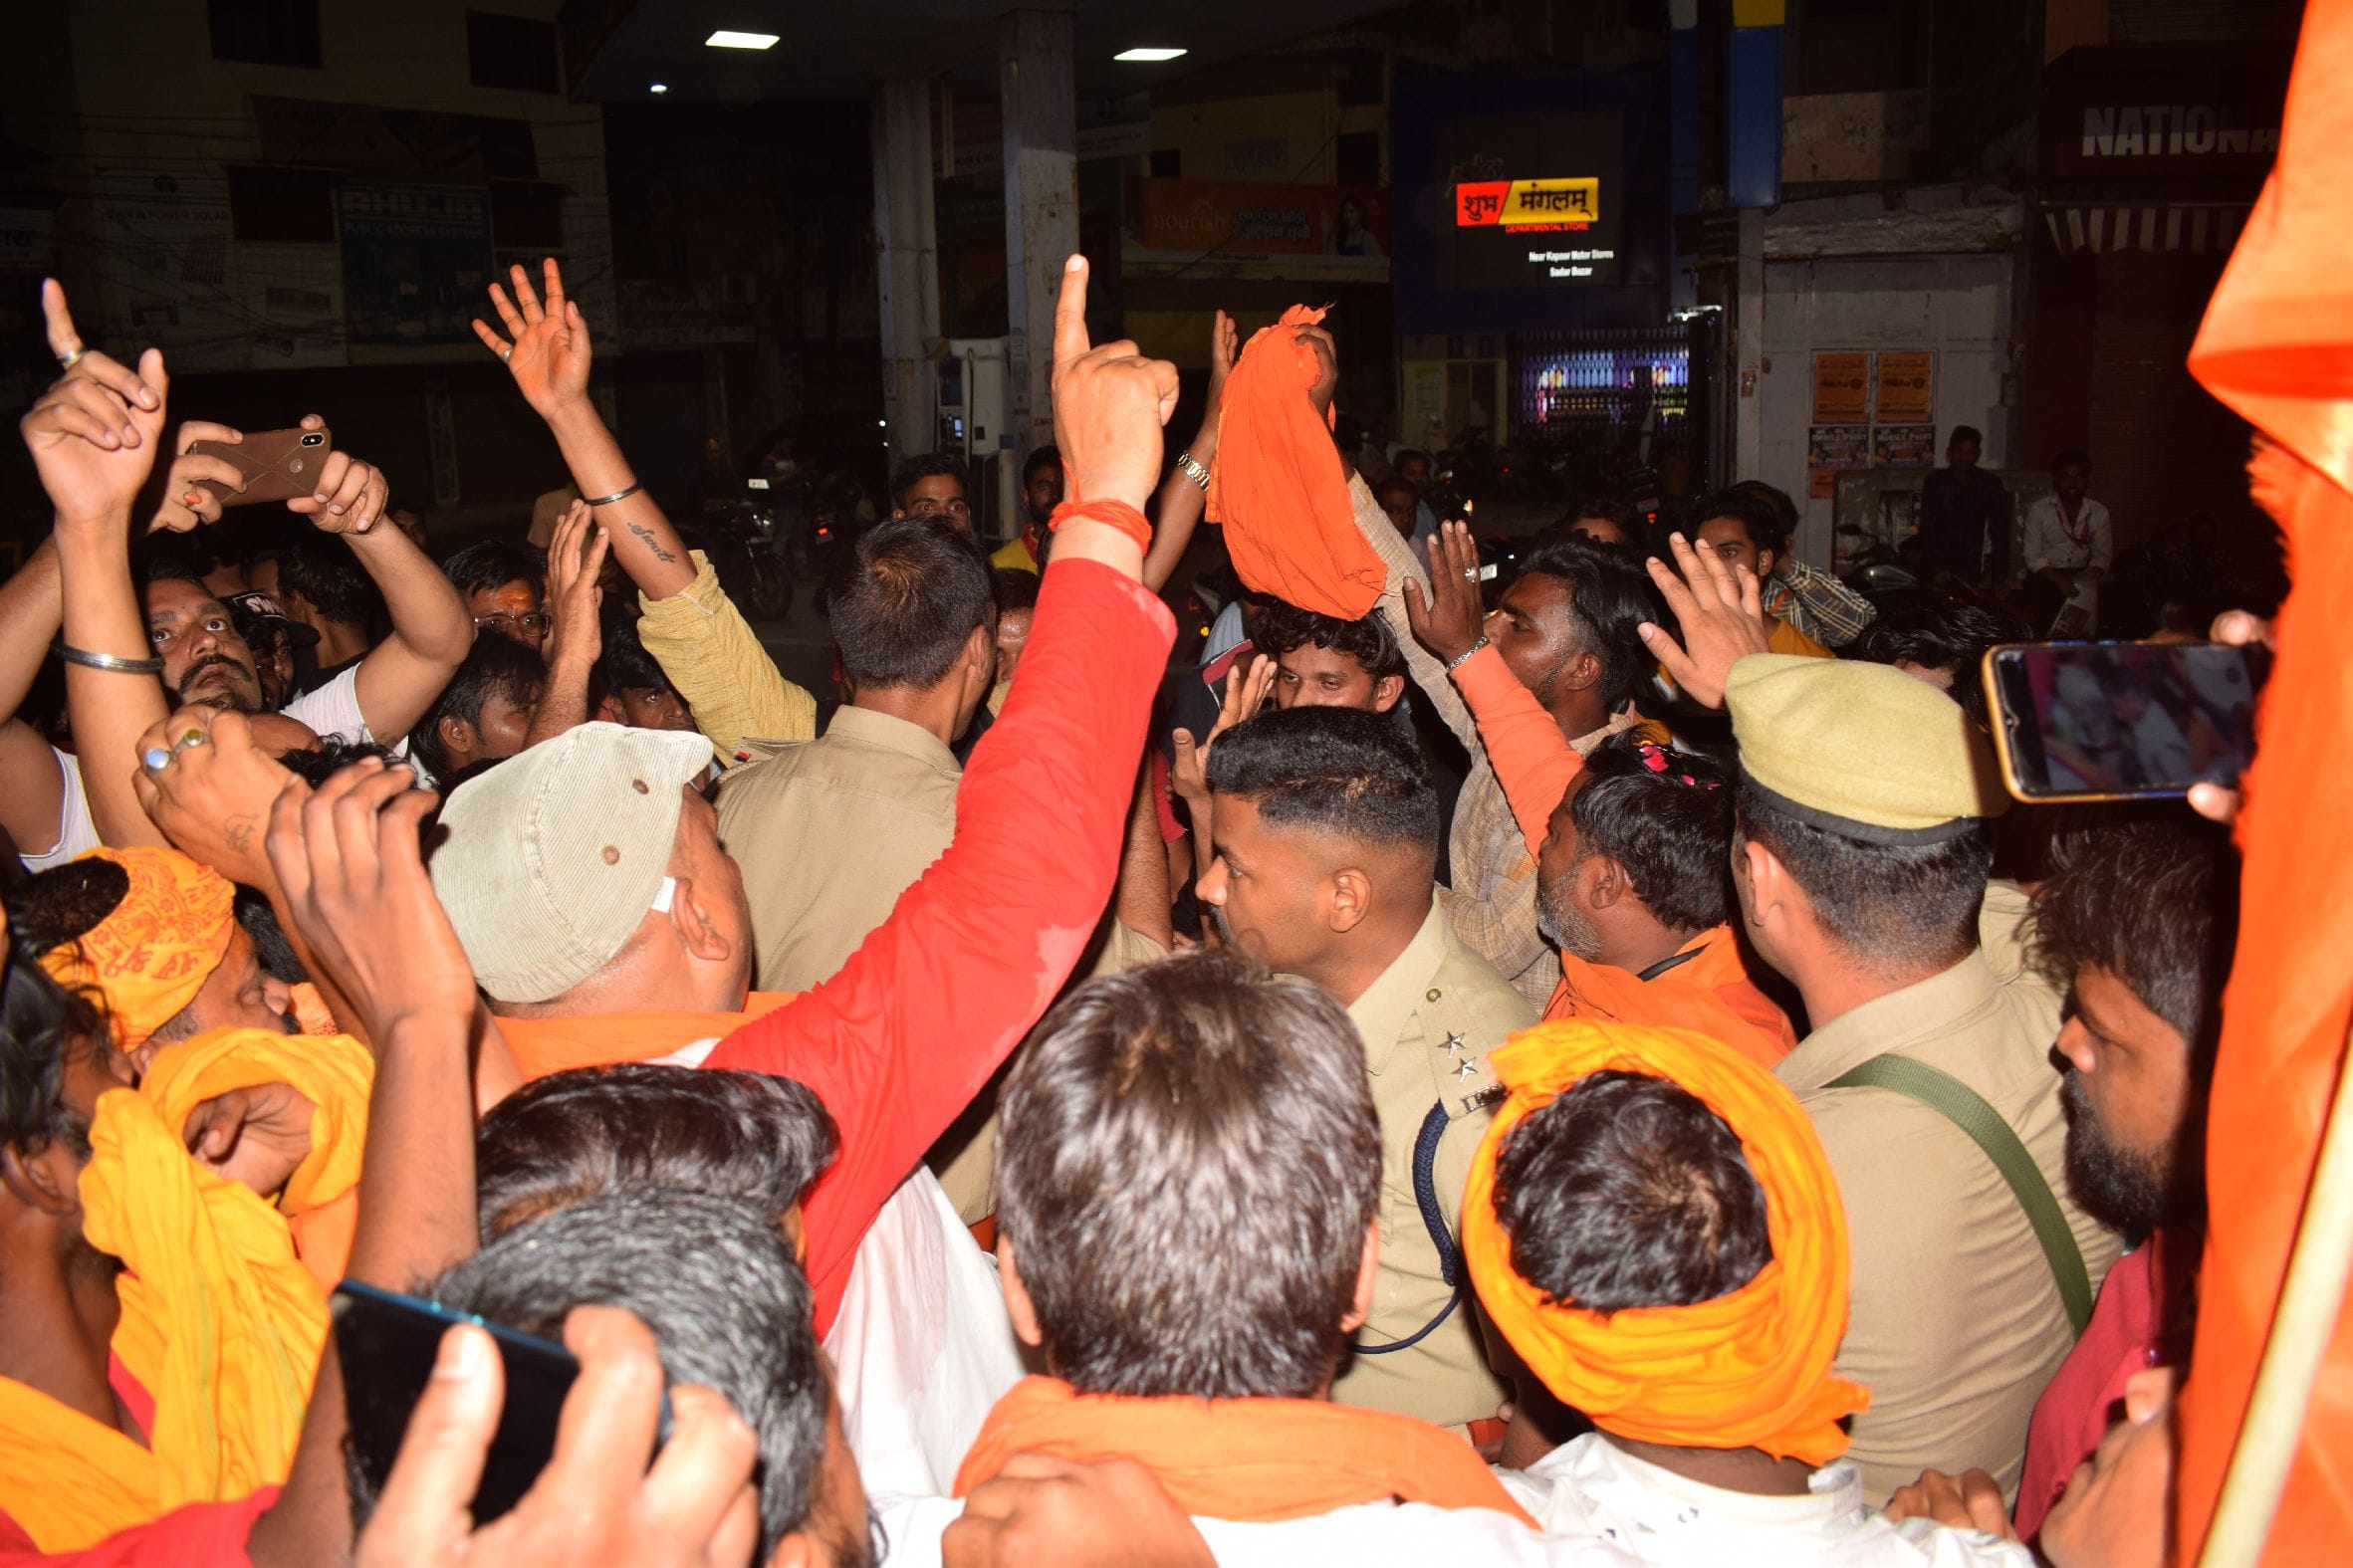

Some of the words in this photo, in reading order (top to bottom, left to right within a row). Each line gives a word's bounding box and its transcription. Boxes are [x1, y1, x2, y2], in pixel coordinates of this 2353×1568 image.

[1463, 194, 1500, 222] शुभ
[1519, 182, 1594, 218] मंगलम्
[1152, 208, 1228, 234] nourish
[1505, 223, 1562, 233] DEPARTMENTAL
[1563, 222, 1590, 231] STORE
